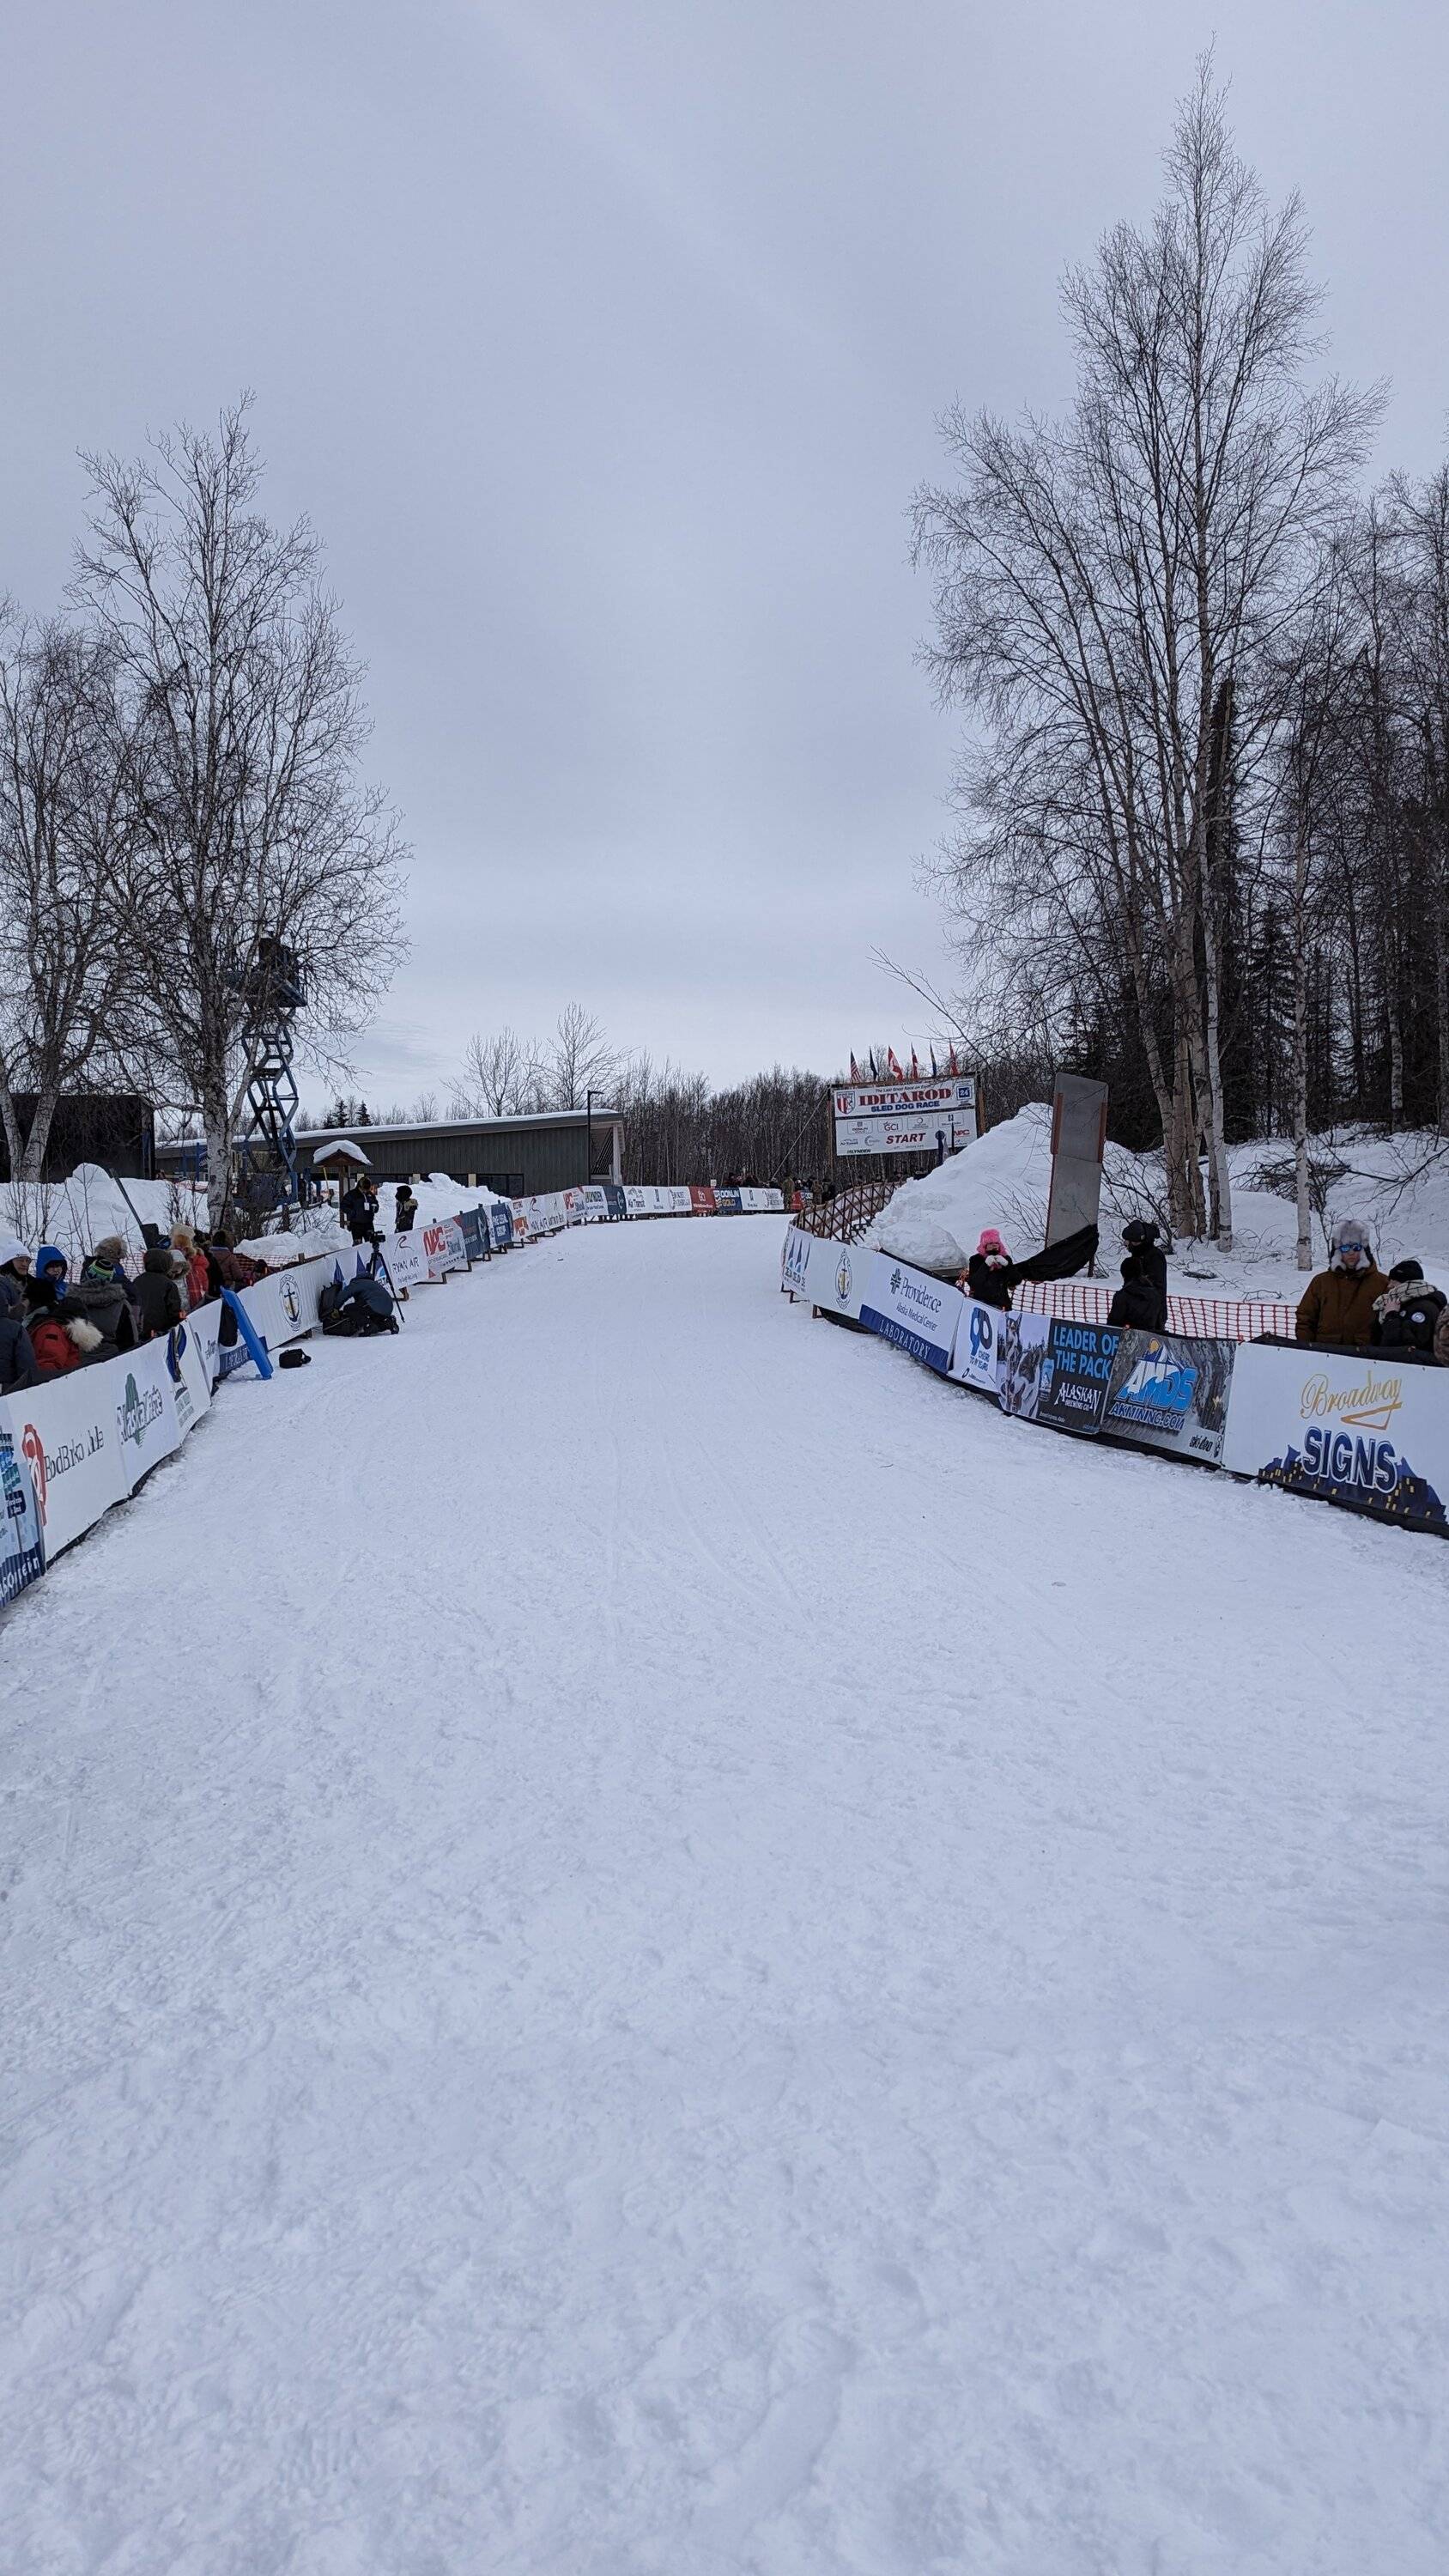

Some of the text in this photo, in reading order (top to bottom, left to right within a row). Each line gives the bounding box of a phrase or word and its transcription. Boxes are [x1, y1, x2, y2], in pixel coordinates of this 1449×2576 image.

[859, 1087, 952, 1106] IDITAROD
[886, 1133, 926, 1145] START
[900, 1277, 942, 1313] Providence
[878, 1319, 931, 1360] LABORATORY
[1053, 1325, 1120, 1356] LEADER OF
[1055, 1349, 1113, 1381] THE PACK
[1053, 1382, 1102, 1416] ALASKAN
[1300, 1370, 1403, 1419] Broadway
[1108, 1401, 1185, 1431] AKMINING.COM
[1301, 1426, 1398, 1494] SIGNS
